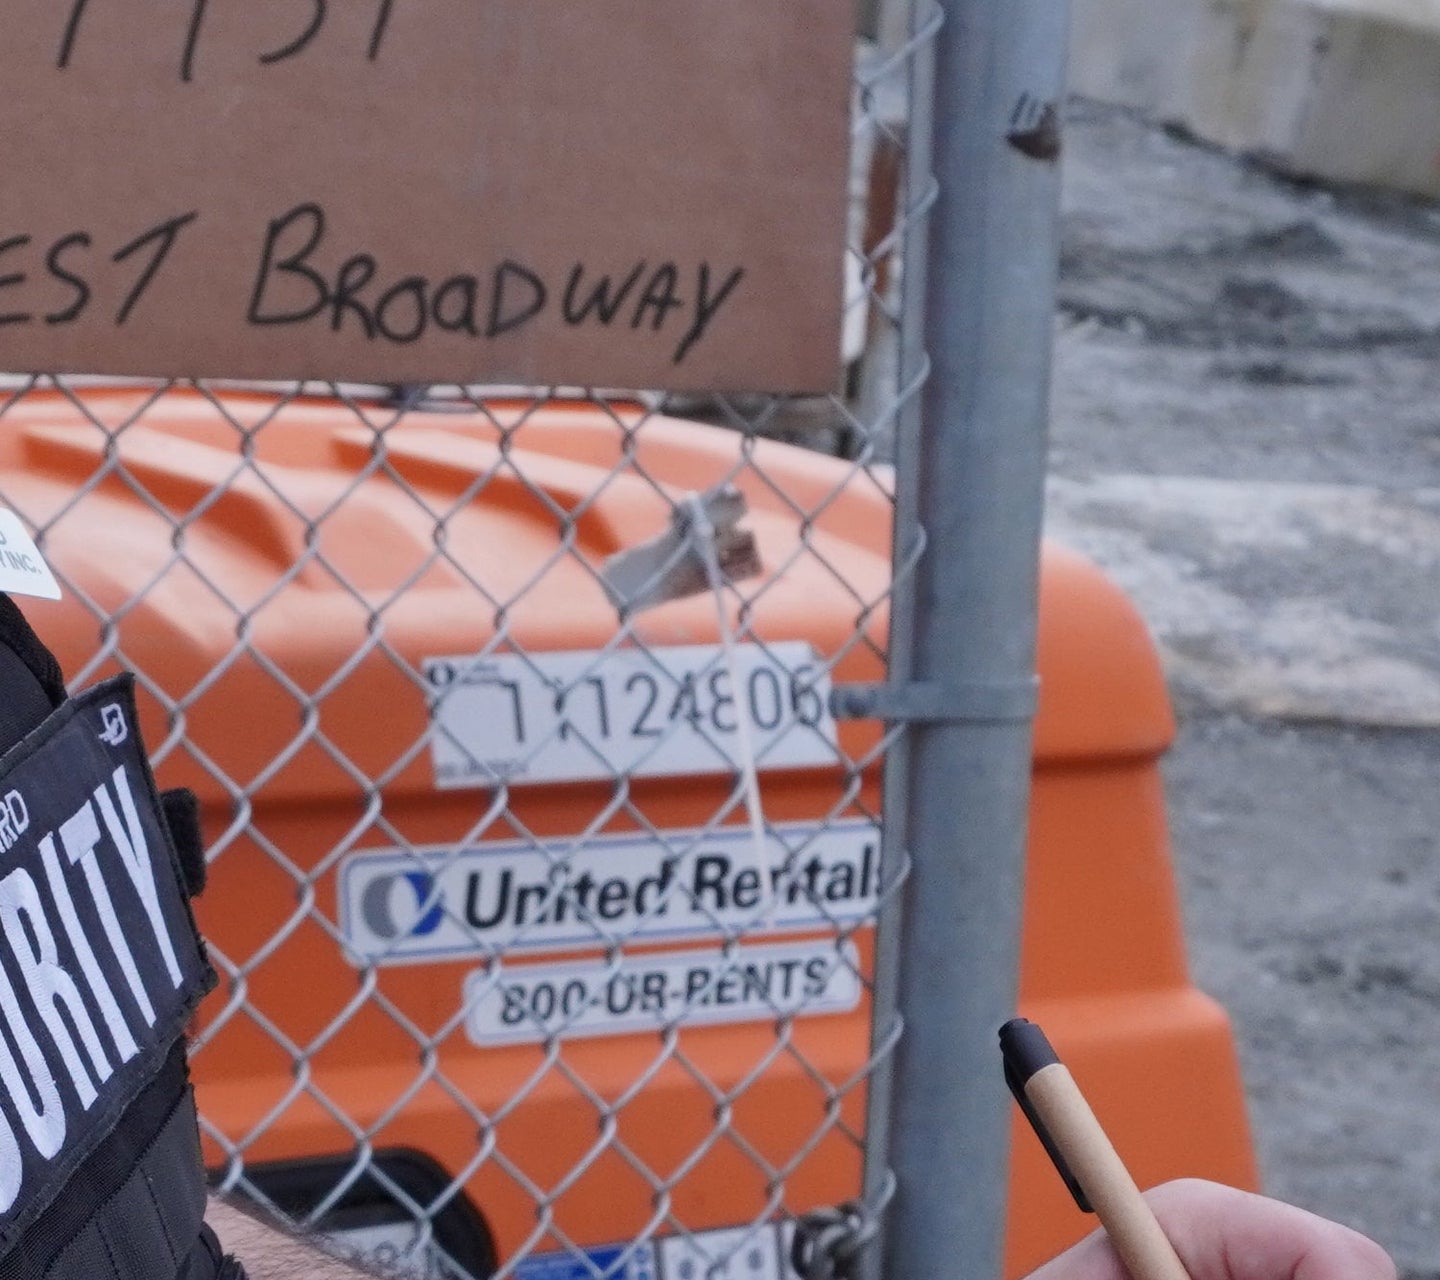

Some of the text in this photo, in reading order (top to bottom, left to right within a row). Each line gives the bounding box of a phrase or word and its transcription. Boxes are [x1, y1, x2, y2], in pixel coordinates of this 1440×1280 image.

[9, 551, 43, 575] INC.
[463, 844, 883, 930] United Rental
[501, 957, 829, 1026] 800-UR-RENTS
